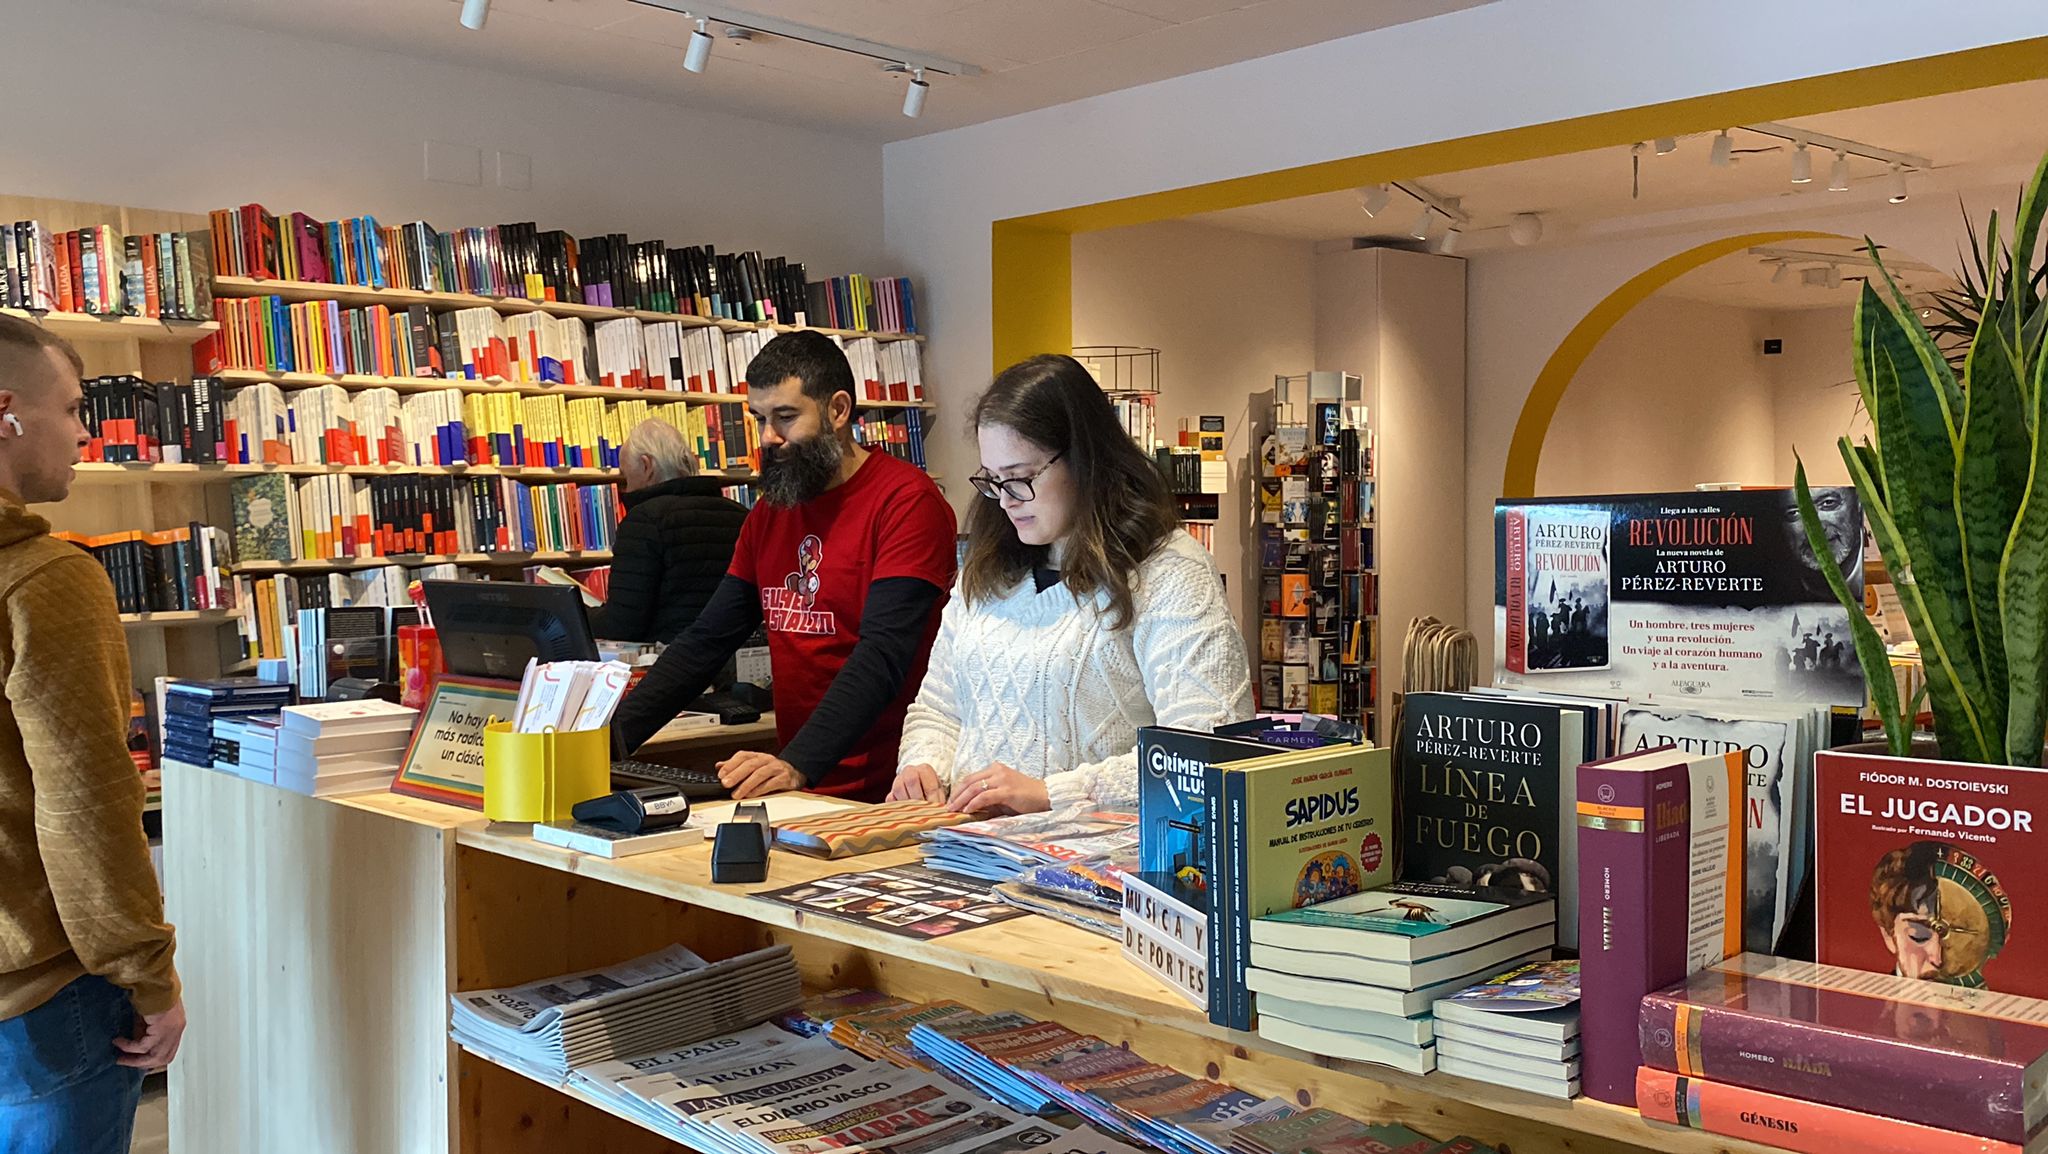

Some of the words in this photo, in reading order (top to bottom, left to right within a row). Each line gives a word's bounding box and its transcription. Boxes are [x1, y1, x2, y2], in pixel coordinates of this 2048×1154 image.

[1661, 507, 1680, 515] Llega
[1699, 506, 1720, 514] calles
[1535, 524, 1601, 539] ARTURO
[1629, 512, 1754, 546] REVOLUCIÓN
[1512, 518, 1521, 571] ARTURO
[1535, 538, 1601, 549] PÉREZ-REVERTE
[1535, 552, 1601, 572] REVOLUCIÓN
[1655, 560, 1727, 574] ARTURO
[1622, 575, 1763, 591] PÉREZ-REVERTE
[762, 587, 810, 612] SUPE
[769, 609, 835, 634] STALIN
[1510, 577, 1521, 651] REVOLUCIÓN
[1629, 620, 1644, 629] Un
[1646, 620, 1689, 630] hombre,
[1690, 621, 1710, 630] tres
[1712, 622, 1755, 633] mujeres
[1647, 636, 1654, 644] y
[1655, 635, 1675, 643] una
[1677, 635, 1735, 644] revolución.
[1622, 646, 1637, 655] Un
[1638, 647, 1662, 657] viaje
[1663, 647, 1673, 656] al
[1675, 648, 1716, 658] corazón
[1719, 649, 1763, 659] humano
[1652, 661, 1658, 670] y
[1669, 660, 1679, 669] la
[1680, 662, 1729, 671] aventura.
[1671, 680, 1711, 689] ALFAGUARA
[448, 710, 464, 724] No
[464, 712, 485, 730] hay
[434, 727, 455, 741] más
[1266, 736, 1315, 744] CARMEN
[1417, 713, 1542, 749] ARTURO
[441, 749, 454, 761] un
[1416, 739, 1542, 766] PÉREZ-REVERTE
[1420, 760, 1536, 807] LÍNEA
[1859, 771, 1905, 786] FIÓDOR
[1908, 776, 1923, 787] M.
[1926, 778, 2009, 795] DOSTOIEVSKI
[654, 799, 676, 810] BBVA
[1284, 786, 1360, 829] SAPIDUS
[1465, 802, 1488, 820] DE
[1840, 793, 1873, 816] EL
[1880, 797, 2032, 833] JUGADOR
[1268, 837, 1290, 848] MANUAL
[1290, 834, 1298, 843] DE
[1298, 826, 1337, 842] INSTRUCCIONES
[1337, 824, 1345, 832] DE
[1345, 822, 1352, 830] TU
[1415, 814, 1542, 860] FUEGO
[1908, 825, 1956, 839] Fernando
[1958, 830, 1997, 844] Vicente
[1195, 925, 1203, 951] Y
[1126, 926, 1204, 994] DEPORTES
[624, 1052, 673, 1071] EL
[1739, 1050, 1775, 1064] HOMERO
[732, 1116, 758, 1129] EL
[760, 1099, 830, 1125] DIARIO
[827, 1081, 892, 1104] VASCO
[818, 1107, 938, 1148] MARCA
[1740, 1111, 1798, 1134] GÉNESIS
